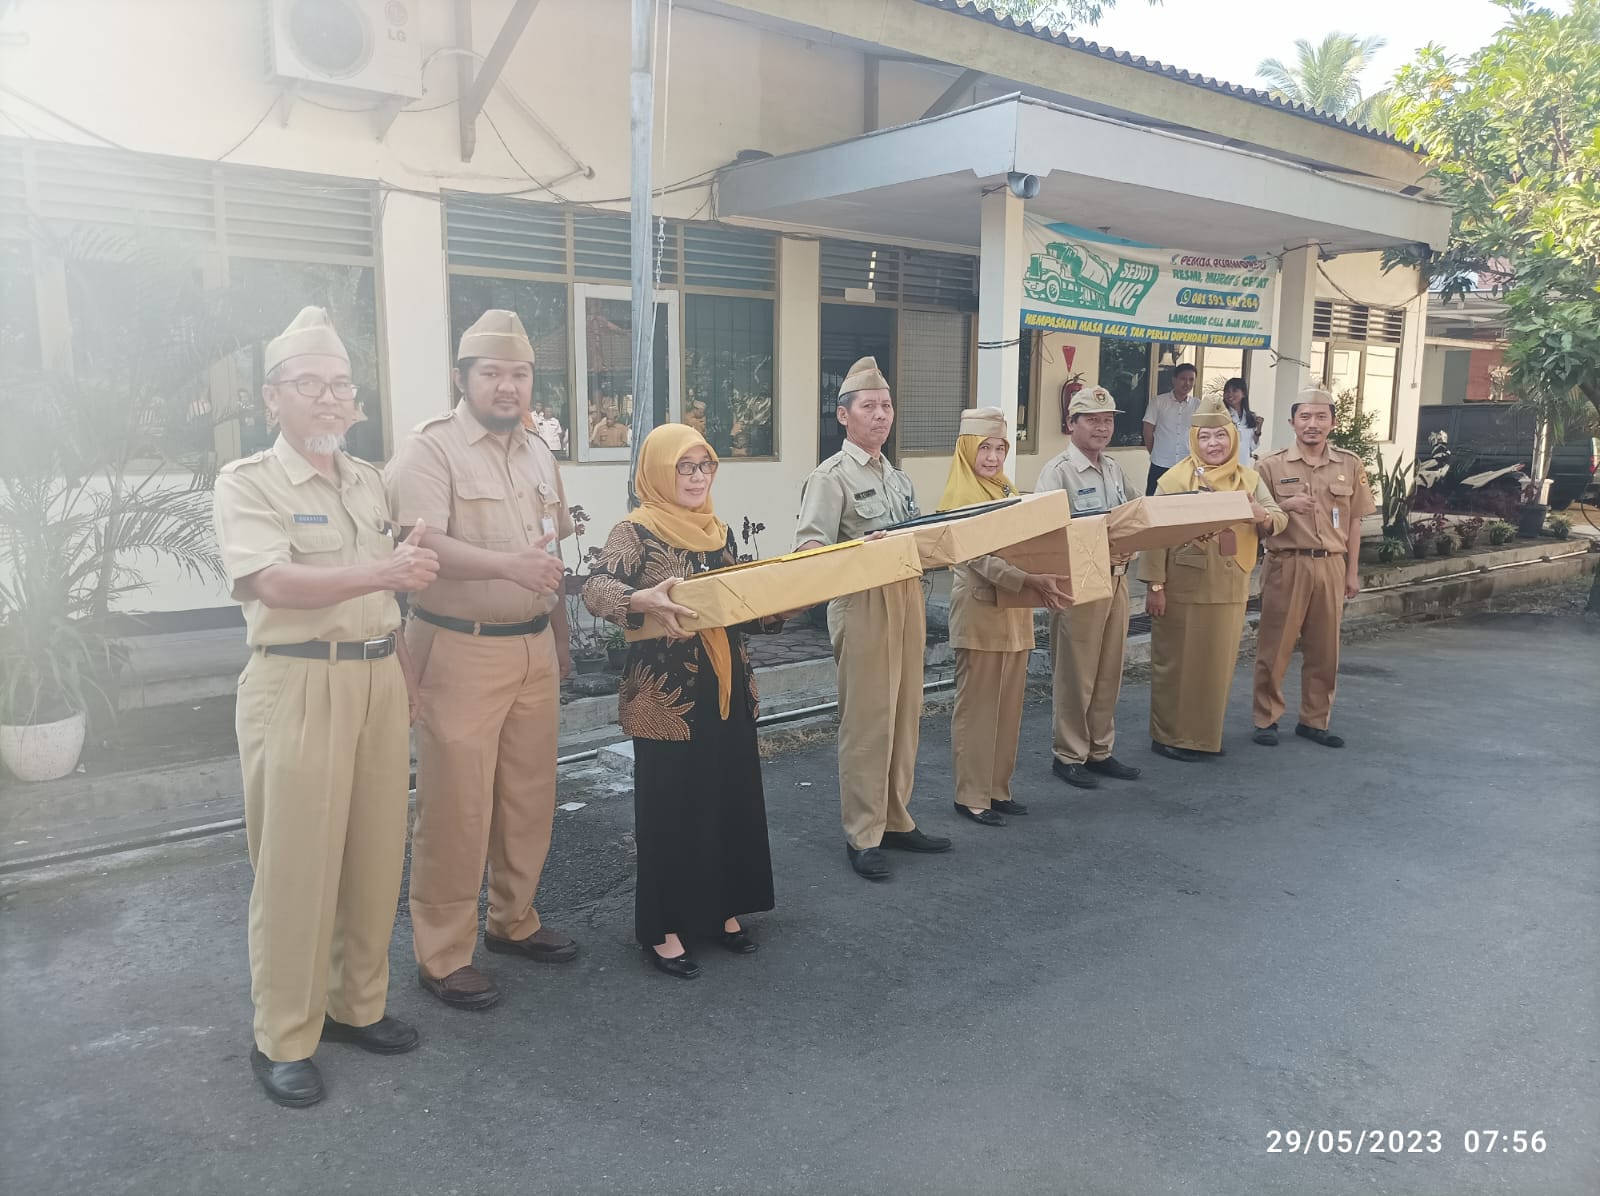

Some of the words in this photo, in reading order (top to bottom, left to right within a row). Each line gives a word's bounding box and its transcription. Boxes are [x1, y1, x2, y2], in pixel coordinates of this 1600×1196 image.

[387, 28, 407, 43] LG
[1108, 280, 1145, 310] WC
[1168, 313, 1207, 326] LANGSUNG
[1079, 320, 1103, 334] MASA
[1130, 326, 1146, 339] TAK
[1146, 327, 1170, 341] PERLU
[1210, 334, 1241, 346] TERLALU
